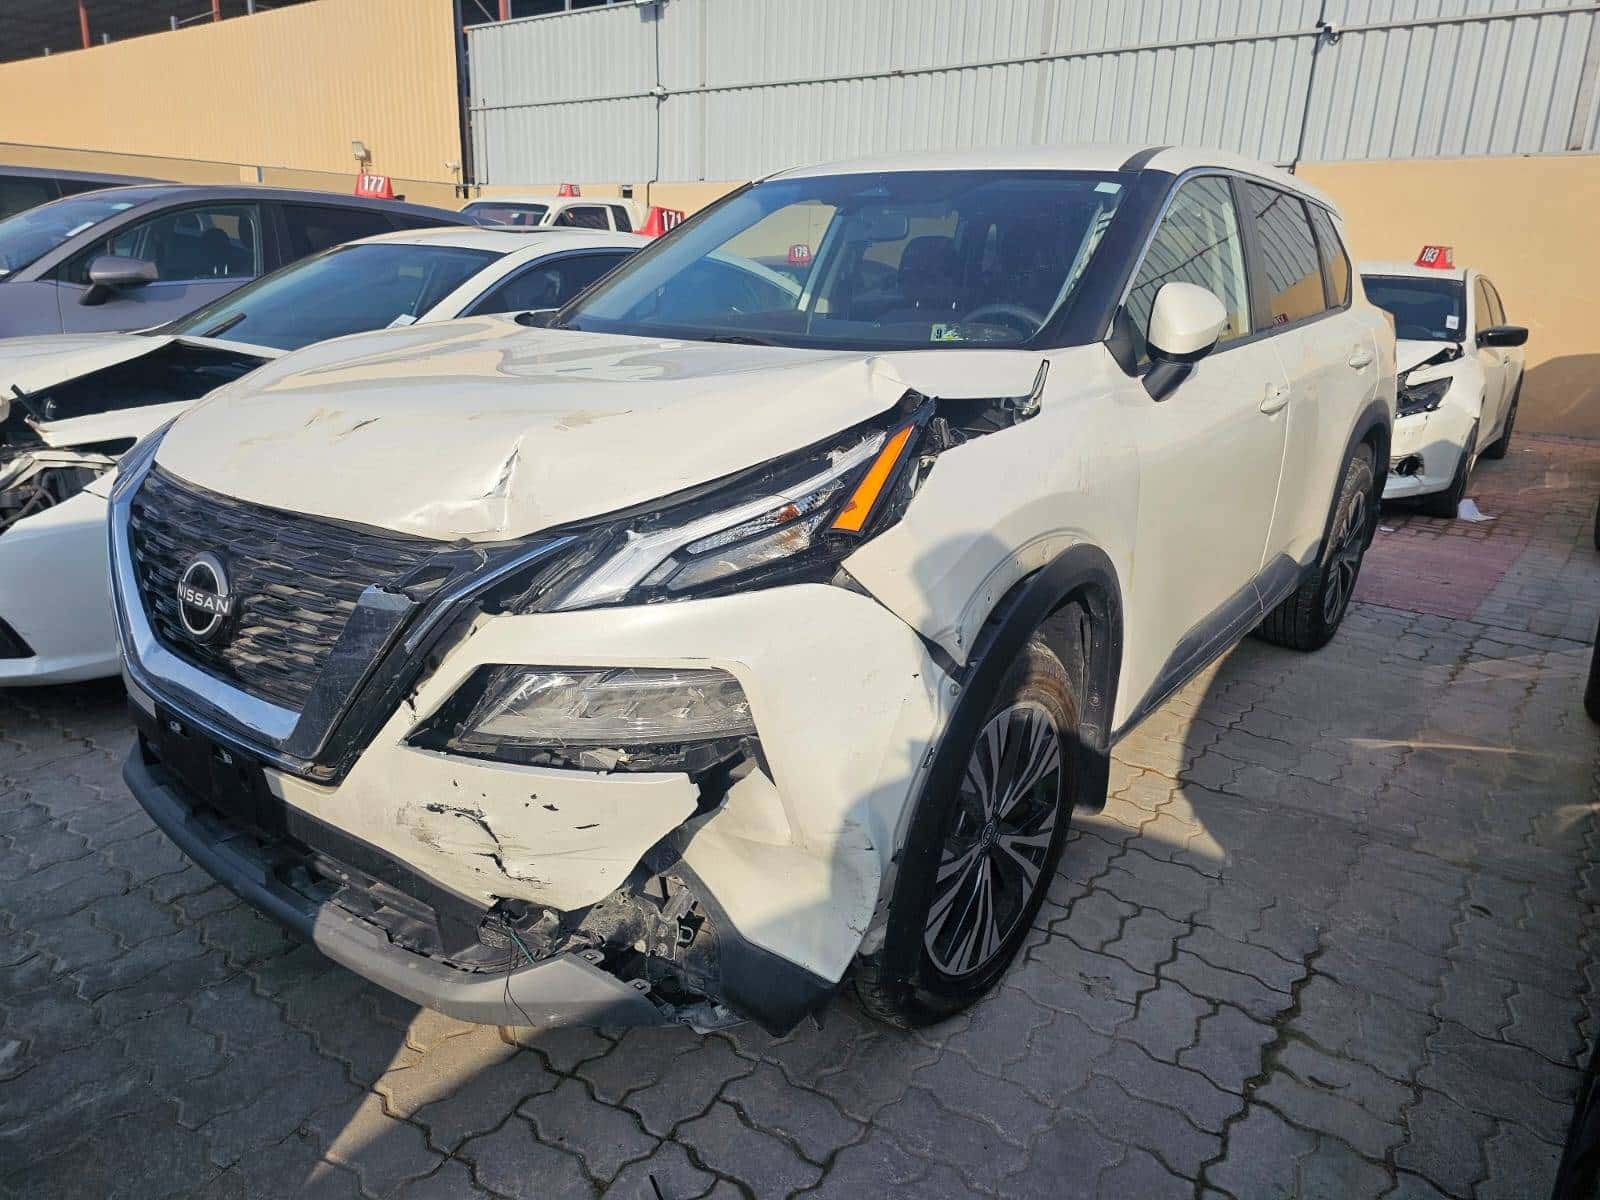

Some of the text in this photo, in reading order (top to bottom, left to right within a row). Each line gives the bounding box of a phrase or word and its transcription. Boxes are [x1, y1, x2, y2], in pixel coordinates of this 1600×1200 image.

[363, 175, 385, 192] 177
[662, 209, 682, 231] 171
[177, 580, 229, 613] NISSAN
